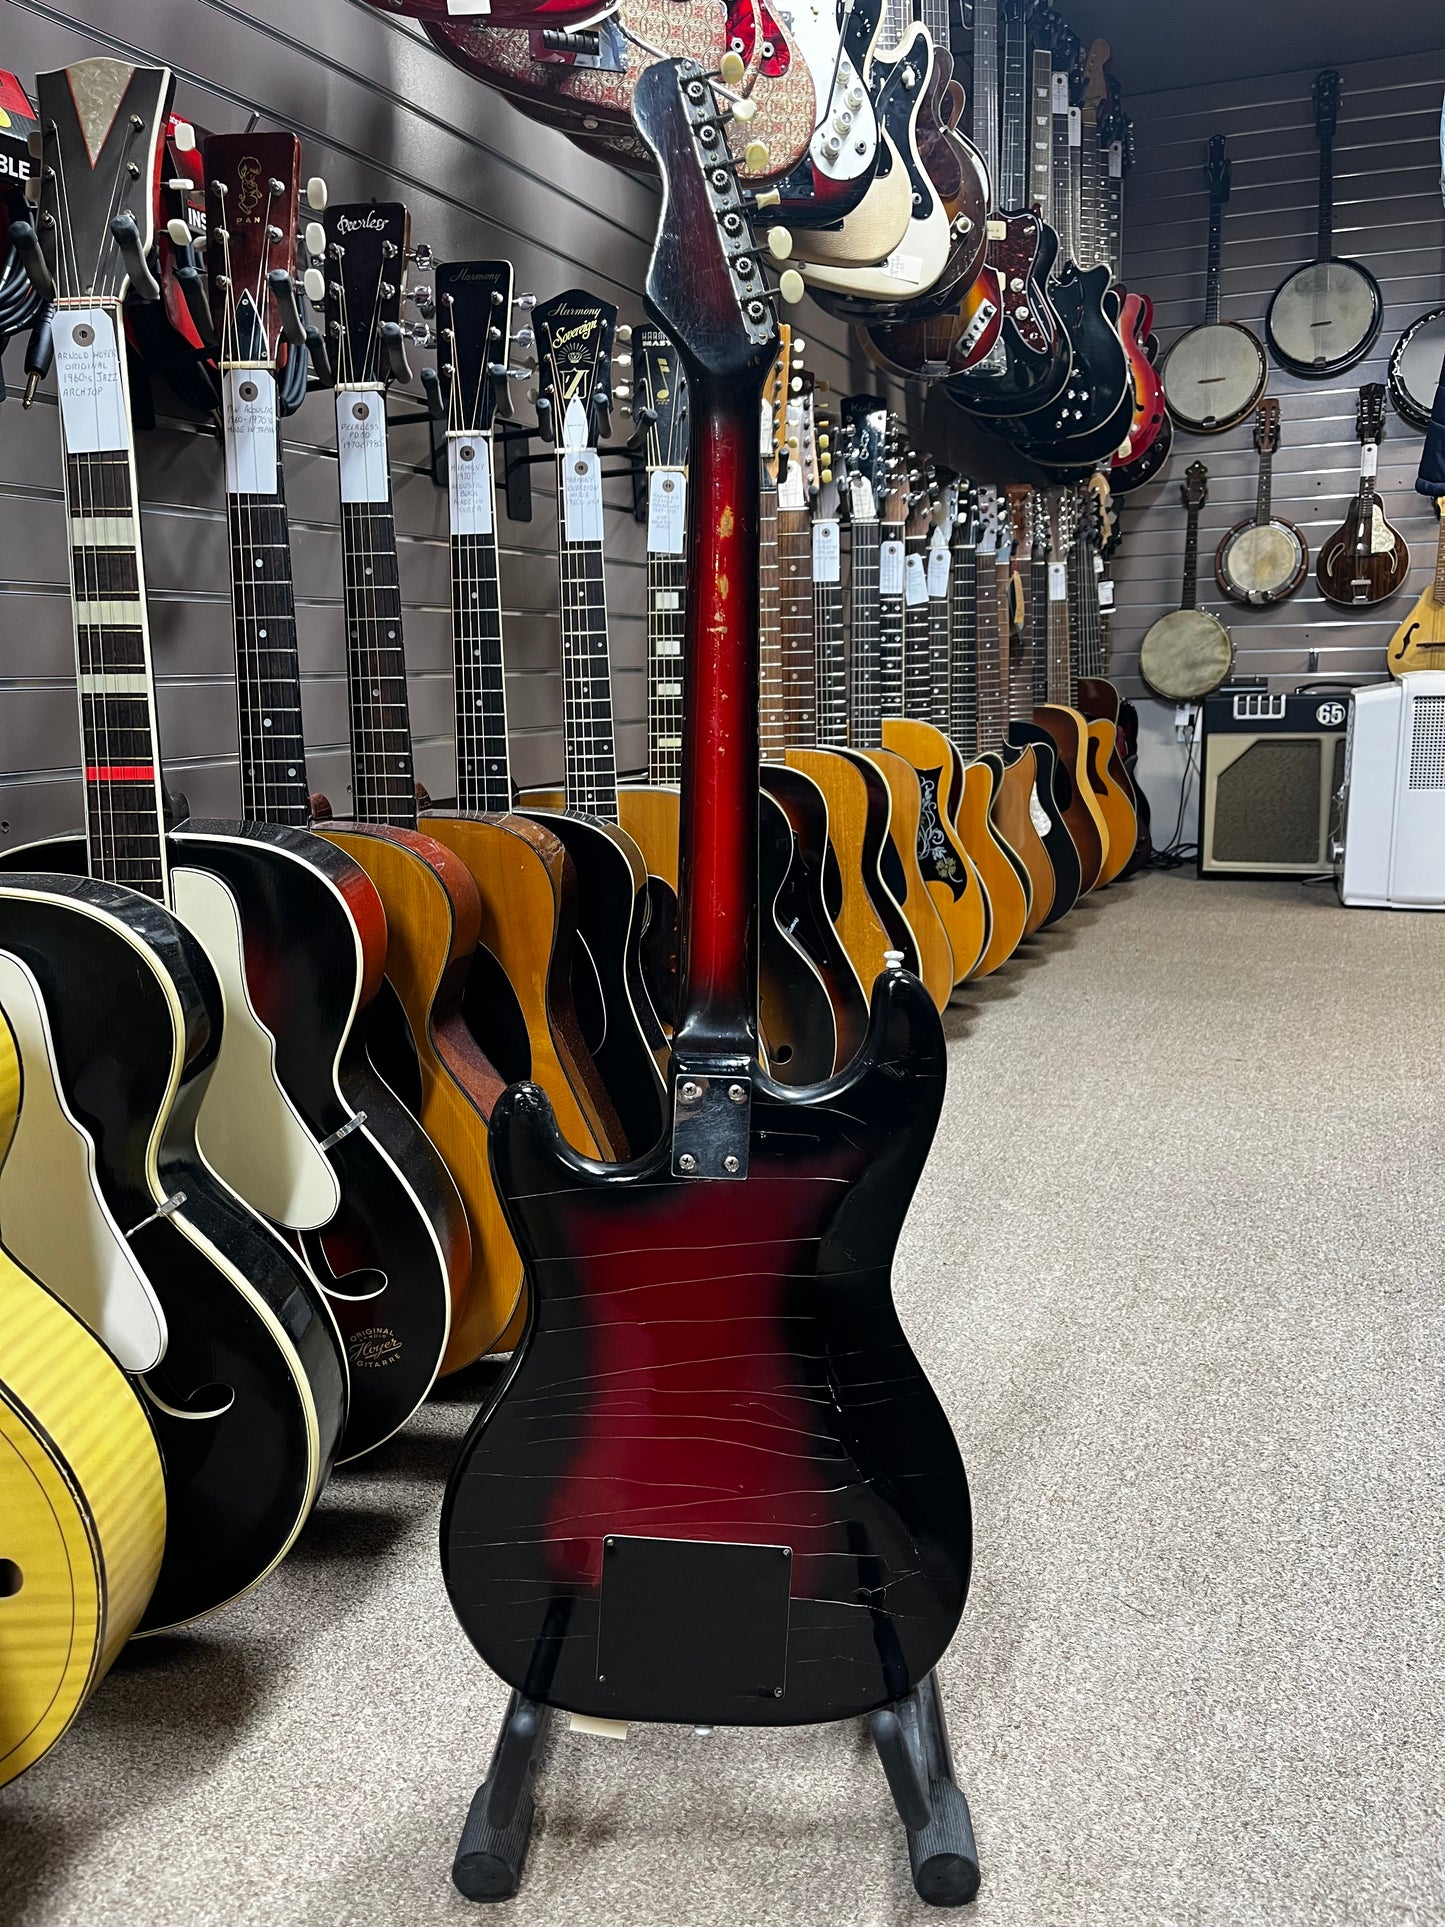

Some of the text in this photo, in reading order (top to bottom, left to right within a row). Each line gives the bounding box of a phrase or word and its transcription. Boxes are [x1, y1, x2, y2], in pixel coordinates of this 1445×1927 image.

[337, 210, 389, 235] Peerless
[449, 268, 501, 284] Harmony
[547, 302, 602, 319] Harmony
[552, 319, 598, 349] Sovereign
[57, 349, 117, 360] ARNOLD HOYER
[64, 361, 108, 371] ORIGINAL
[96, 372, 118, 383] JAZZ
[227, 404, 240, 413] PN
[341, 423, 379, 431] PEERLESS
[451, 482, 483, 490] AOUSTIC
[1319, 703, 1344, 725] 65
[350, 1327, 395, 1342] ORIGINAL
[349, 1338, 403, 1362] Hoyer
[356, 1353, 401, 1368] GITARRE
